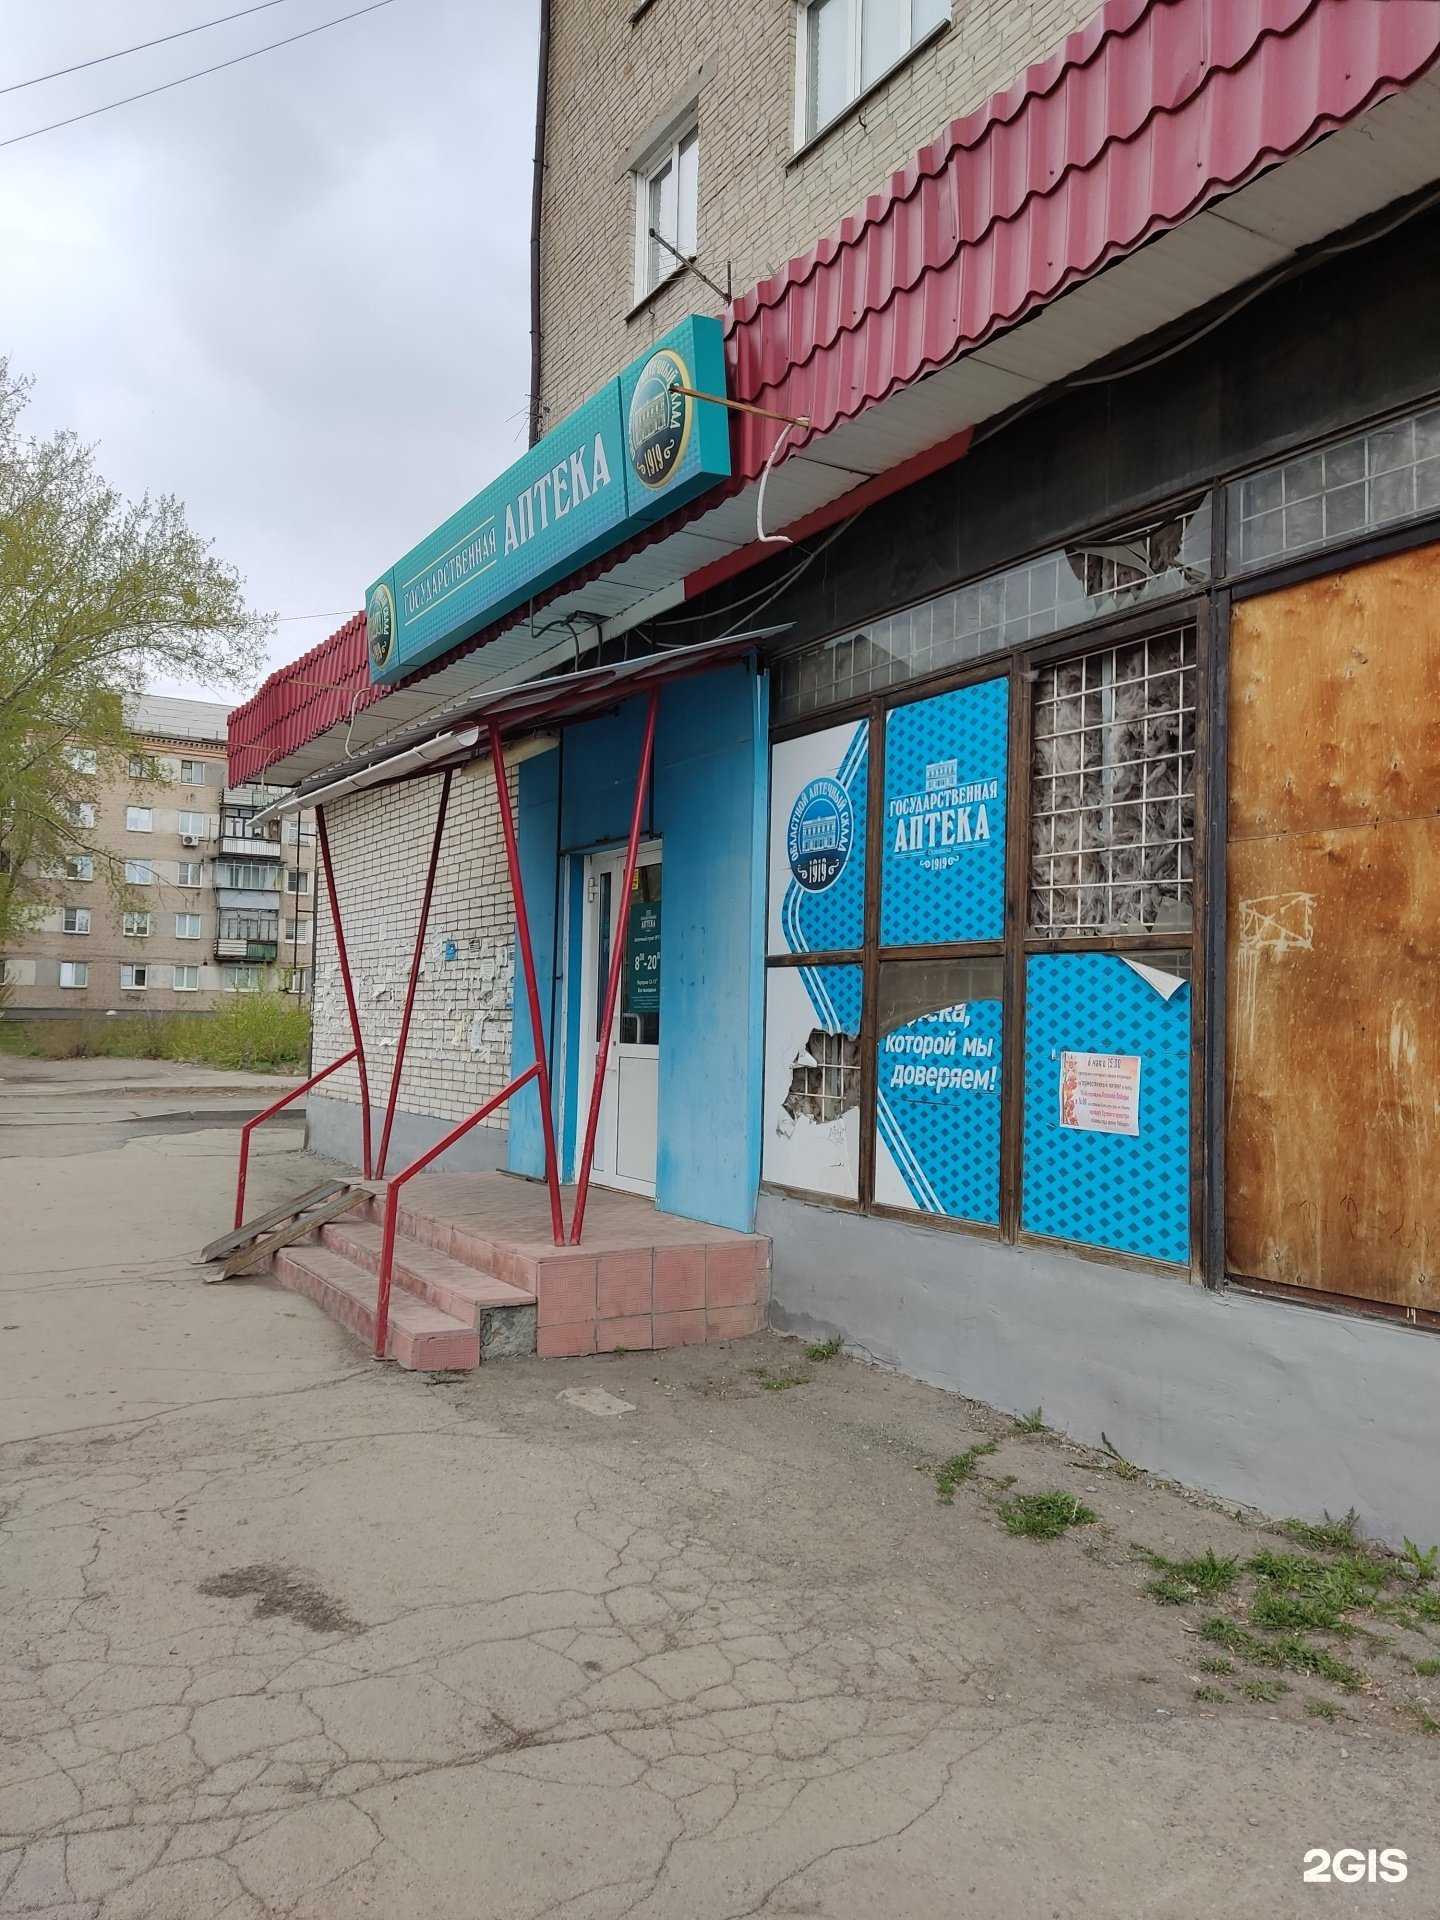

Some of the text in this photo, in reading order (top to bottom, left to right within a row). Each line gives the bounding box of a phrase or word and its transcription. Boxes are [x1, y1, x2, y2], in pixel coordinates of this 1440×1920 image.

[644, 443, 665, 477] 1919
[404, 527, 497, 617] ГОСУДАРСТВЕННАЯ
[504, 432, 612, 557] АПТЕКА
[889, 780, 999, 817] ГОСУДАРСТВЕННАЯ
[789, 781, 851, 862] ОБЛАСТНОЙ АПТЕЧНЫЙ СКЛАД
[894, 803, 991, 853] АПТЕКА
[808, 857, 827, 884] 1919
[931, 857, 947, 870] 1919
[885, 1029, 994, 1060] которой мы
[890, 1064, 998, 1095] доверяем!
